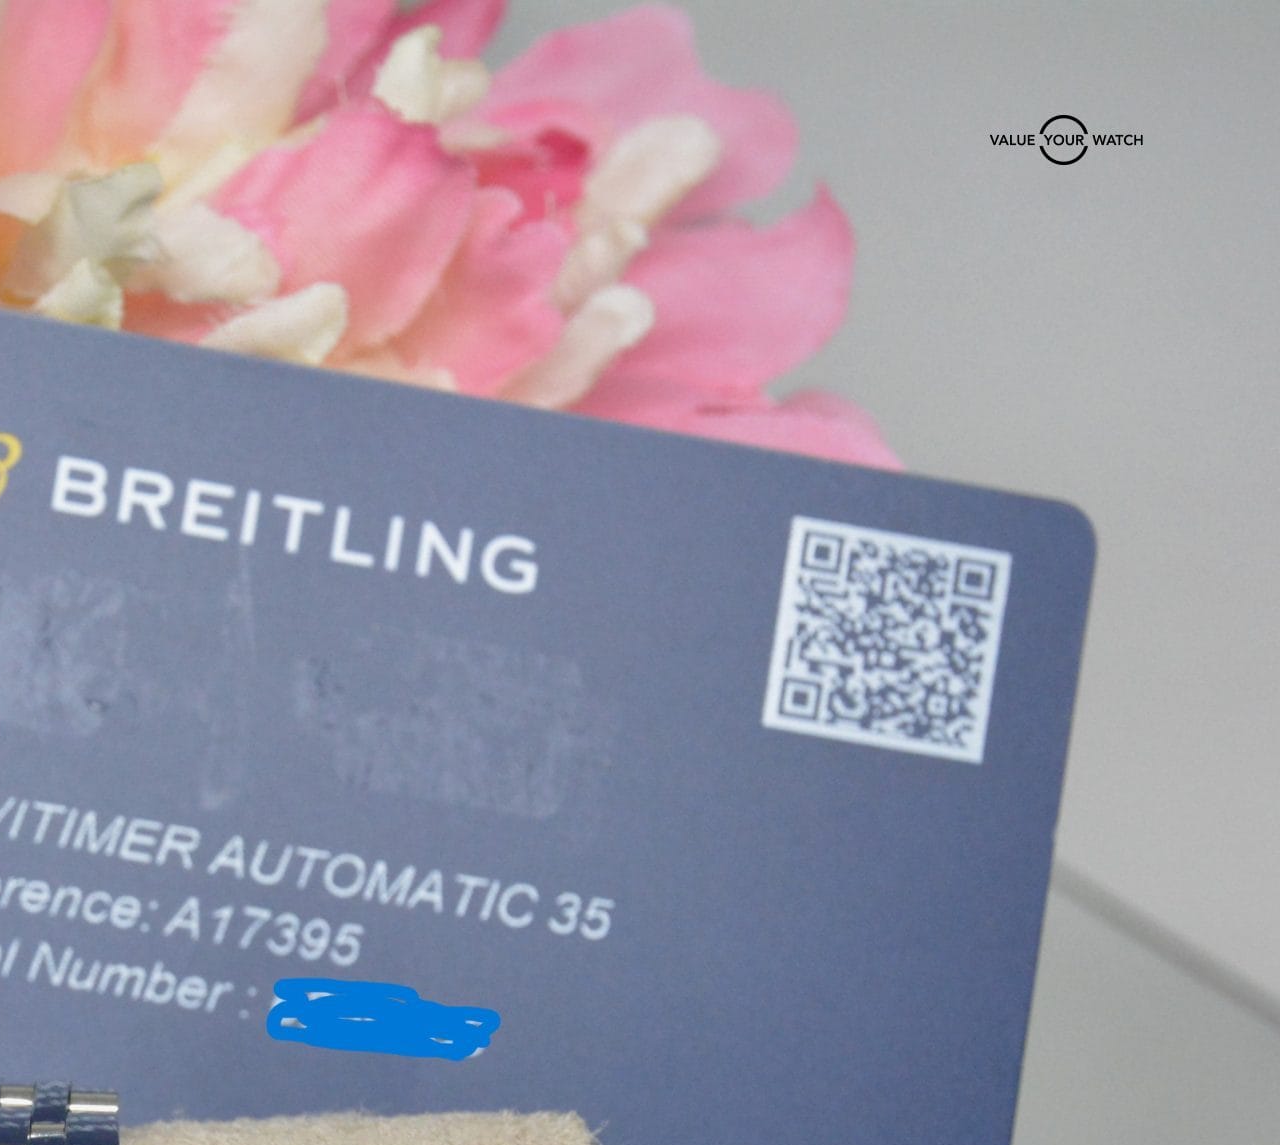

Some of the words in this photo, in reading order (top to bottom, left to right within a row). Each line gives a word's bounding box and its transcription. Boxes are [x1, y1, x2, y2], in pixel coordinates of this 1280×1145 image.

[49, 455, 540, 594] BREITLING
[163, 895, 366, 968] A17395
[207, 832, 541, 930] AUTOMATIC
[546, 891, 617, 941] 35
